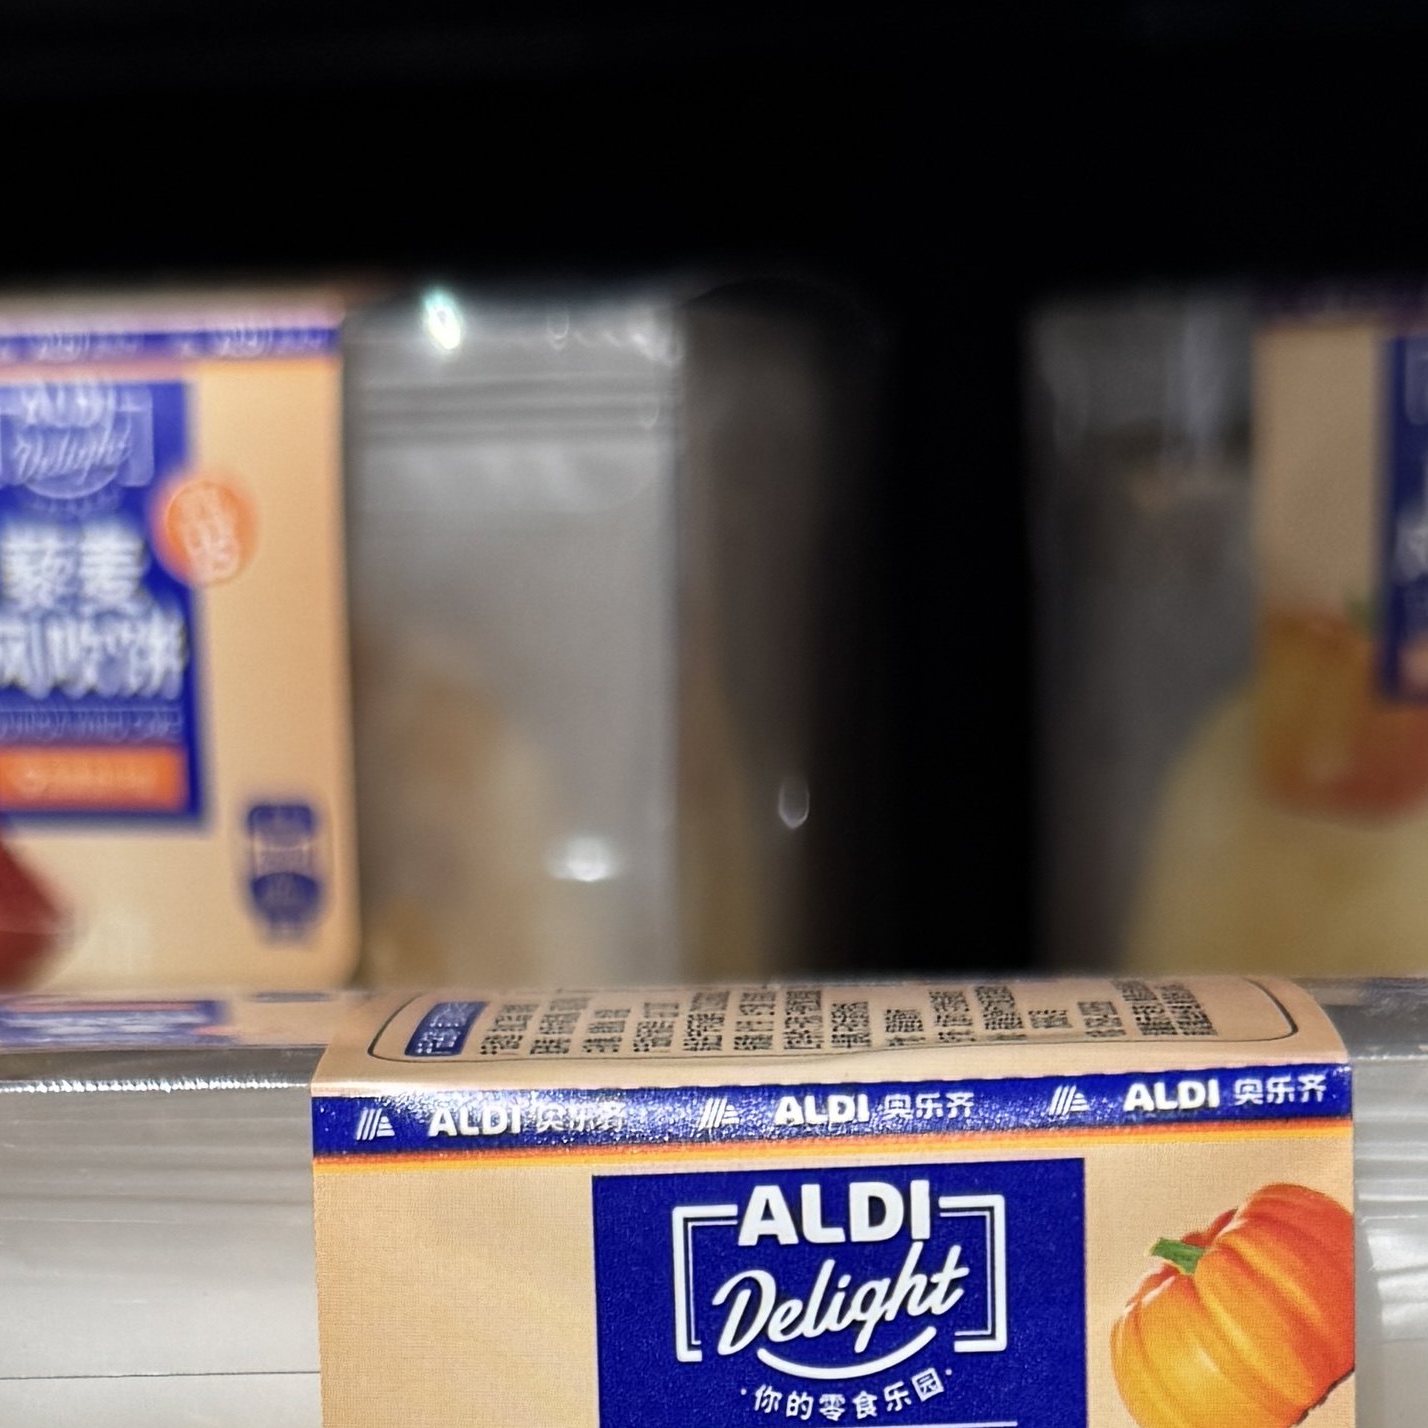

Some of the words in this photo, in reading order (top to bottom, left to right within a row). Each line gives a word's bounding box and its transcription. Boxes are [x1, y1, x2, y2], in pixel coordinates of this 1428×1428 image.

[775, 1093, 870, 1125] ALDI
[882, 1090, 975, 1120] 奥乐齐
[1123, 1080, 1219, 1112] ALDI
[1234, 1073, 1327, 1105] 奥乐齐
[428, 1101, 521, 1136] ALDI
[738, 1179, 930, 1246] ALDI
[712, 1240, 969, 1356] Delight
[753, 1366, 945, 1421] 你的零食乐园
